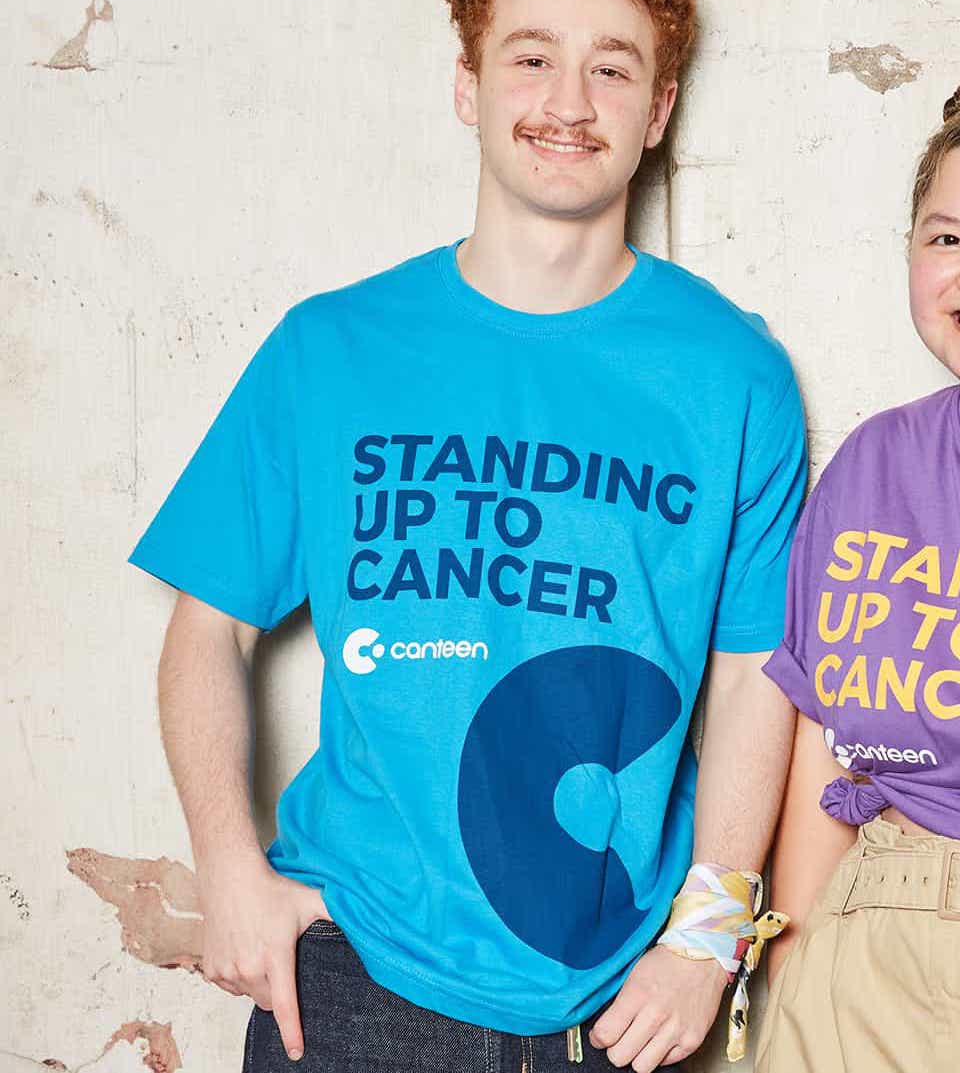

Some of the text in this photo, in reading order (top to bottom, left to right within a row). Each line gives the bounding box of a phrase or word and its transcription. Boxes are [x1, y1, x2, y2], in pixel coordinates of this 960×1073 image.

[354, 434, 697, 525] STANDING
[353, 490, 543, 548] UP TO
[347, 548, 617, 624] CANCER
[817, 591, 891, 645] UP
[390, 639, 489, 660] canteen
